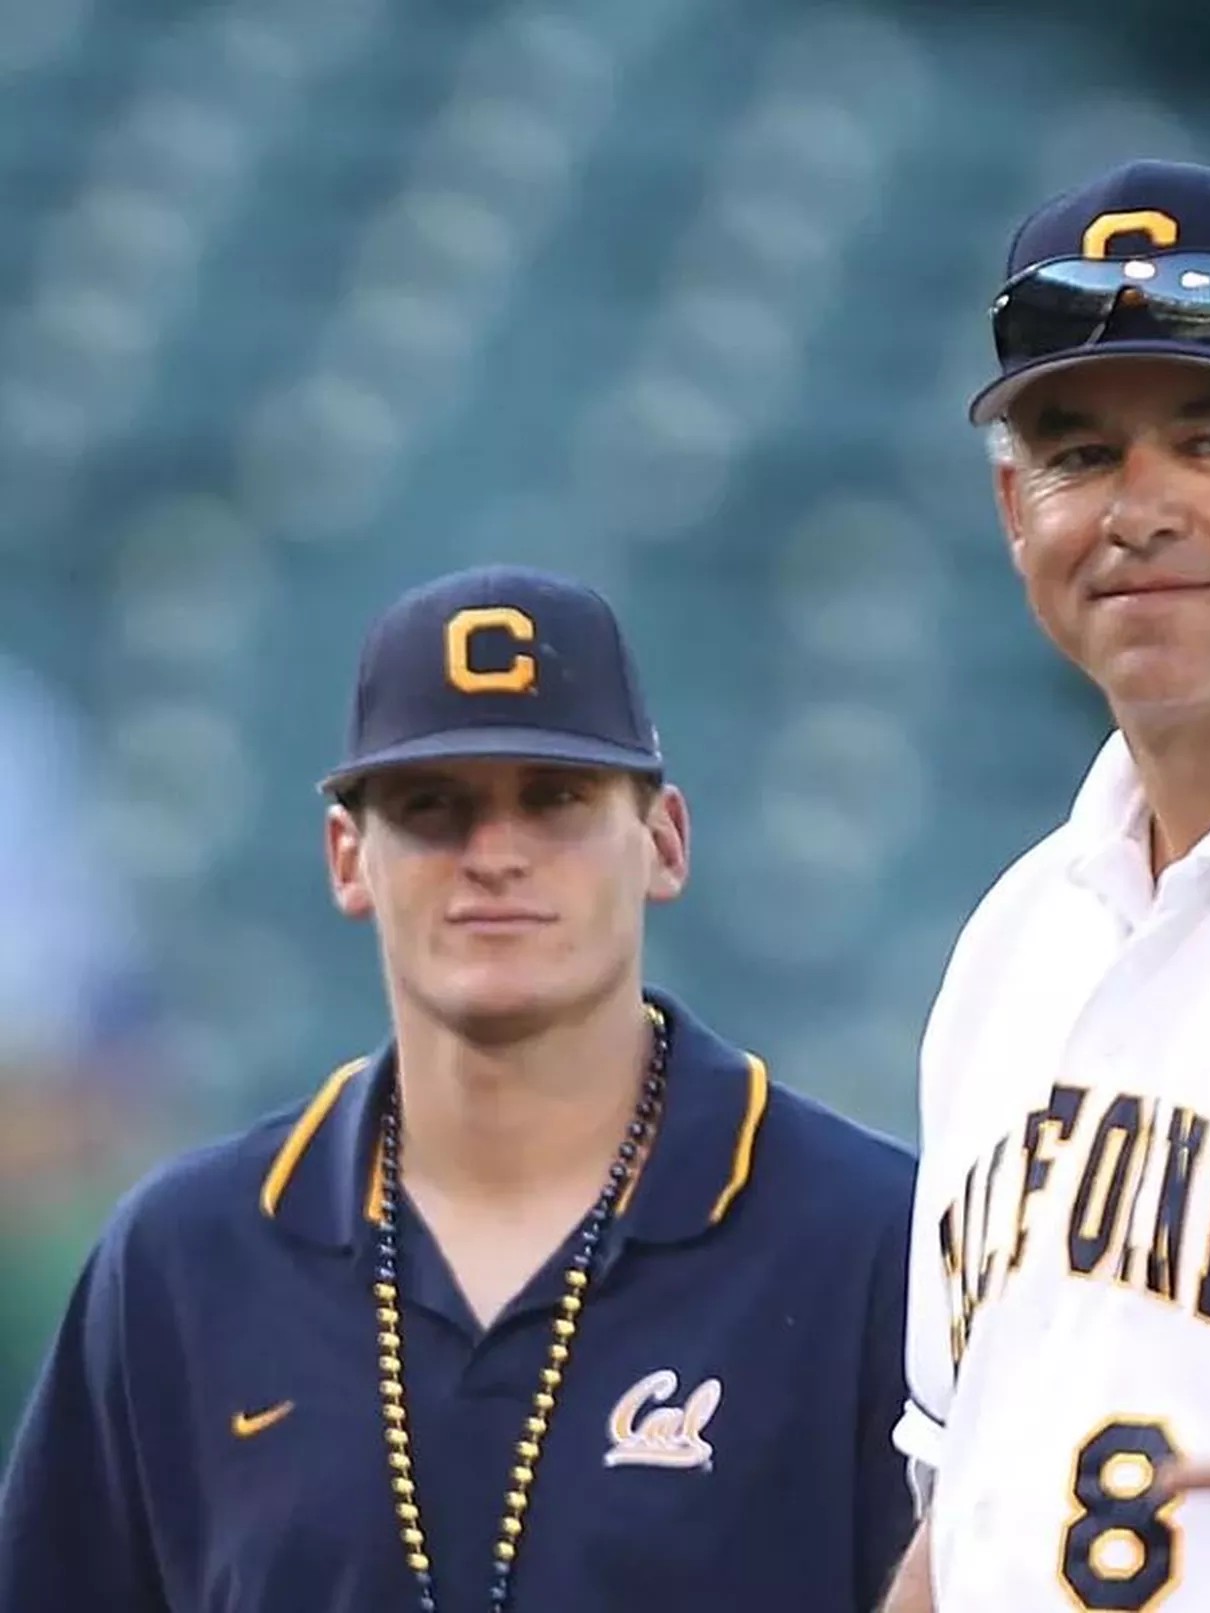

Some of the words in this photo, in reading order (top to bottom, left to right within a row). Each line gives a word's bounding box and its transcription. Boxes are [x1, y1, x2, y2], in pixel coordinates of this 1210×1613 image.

[446, 607, 536, 693] C
[604, 1369, 722, 1469] Cal
[1059, 1412, 1182, 1612] 8
